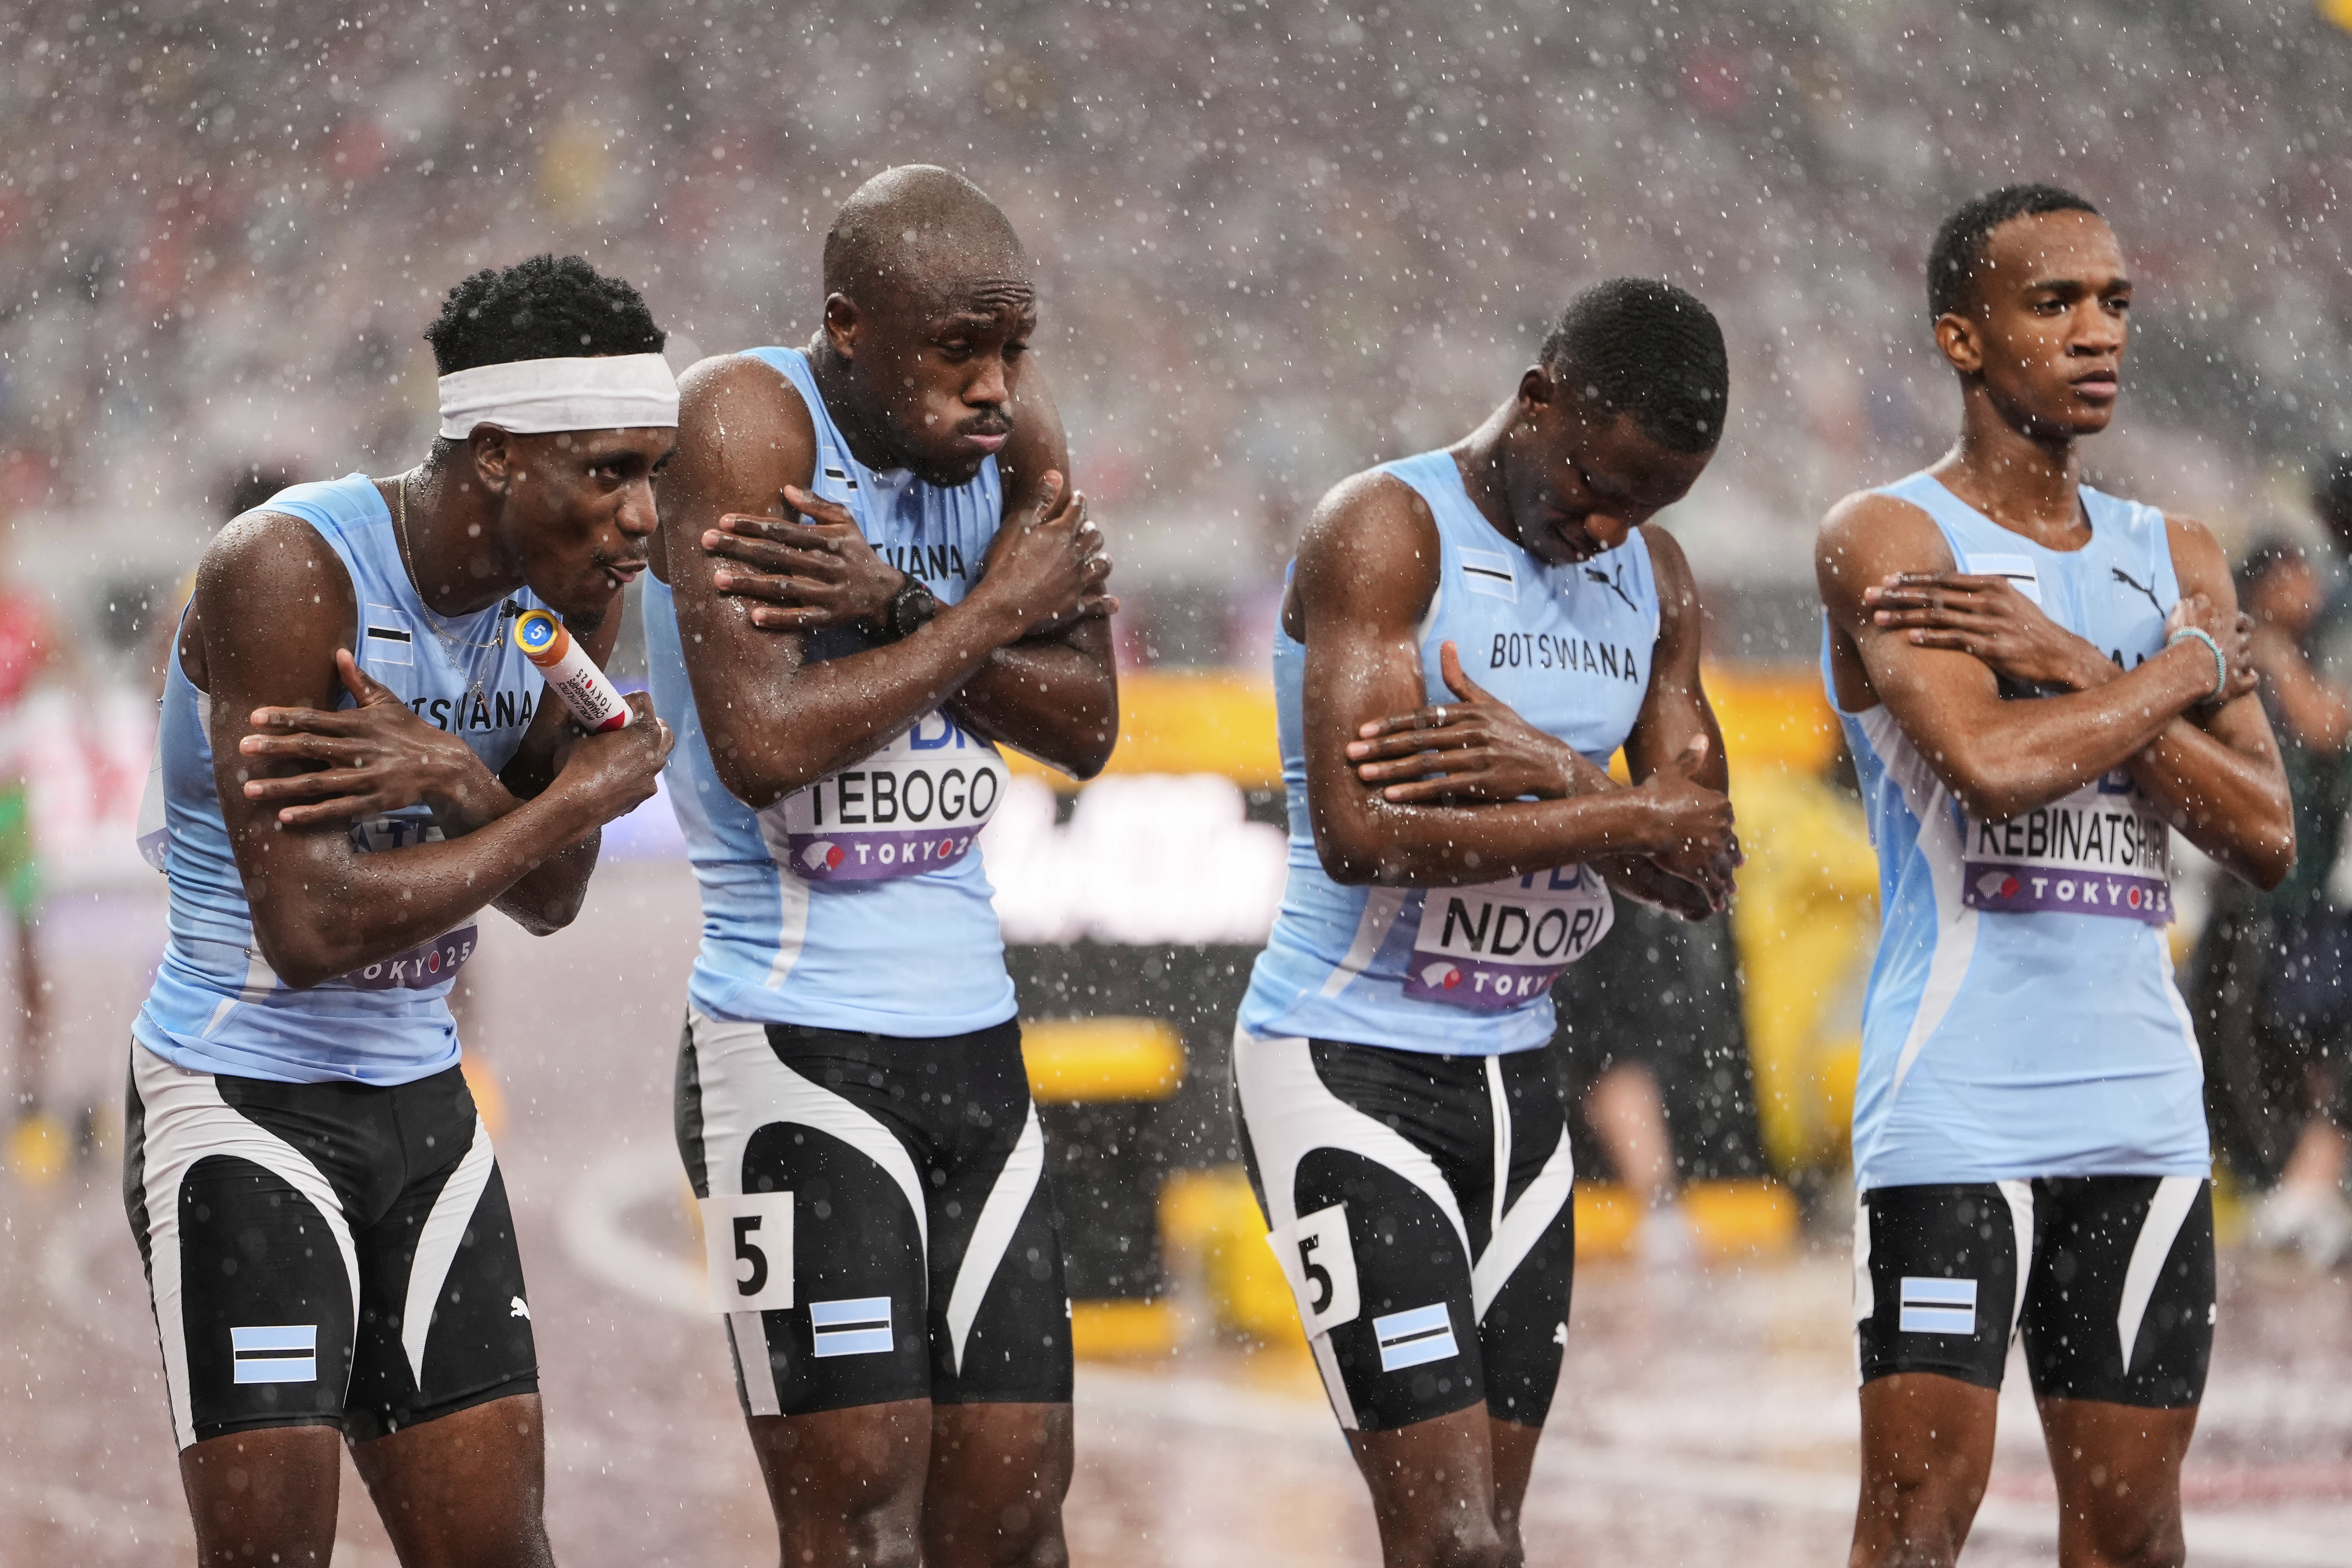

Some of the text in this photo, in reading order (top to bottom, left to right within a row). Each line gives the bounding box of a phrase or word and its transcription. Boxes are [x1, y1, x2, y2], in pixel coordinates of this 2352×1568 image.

[531, 624, 546, 639] 5
[1491, 633, 1638, 685] BOTSWANA
[557, 682, 595, 721] WORLD ATHLETICS
[567, 678, 605, 719] CHAMPIONSHIPS
[813, 767, 997, 826] TEBOGO
[1440, 897, 1603, 958] NDORI
[733, 1216, 768, 1296] 5
[1299, 1234, 1332, 1315] 5
